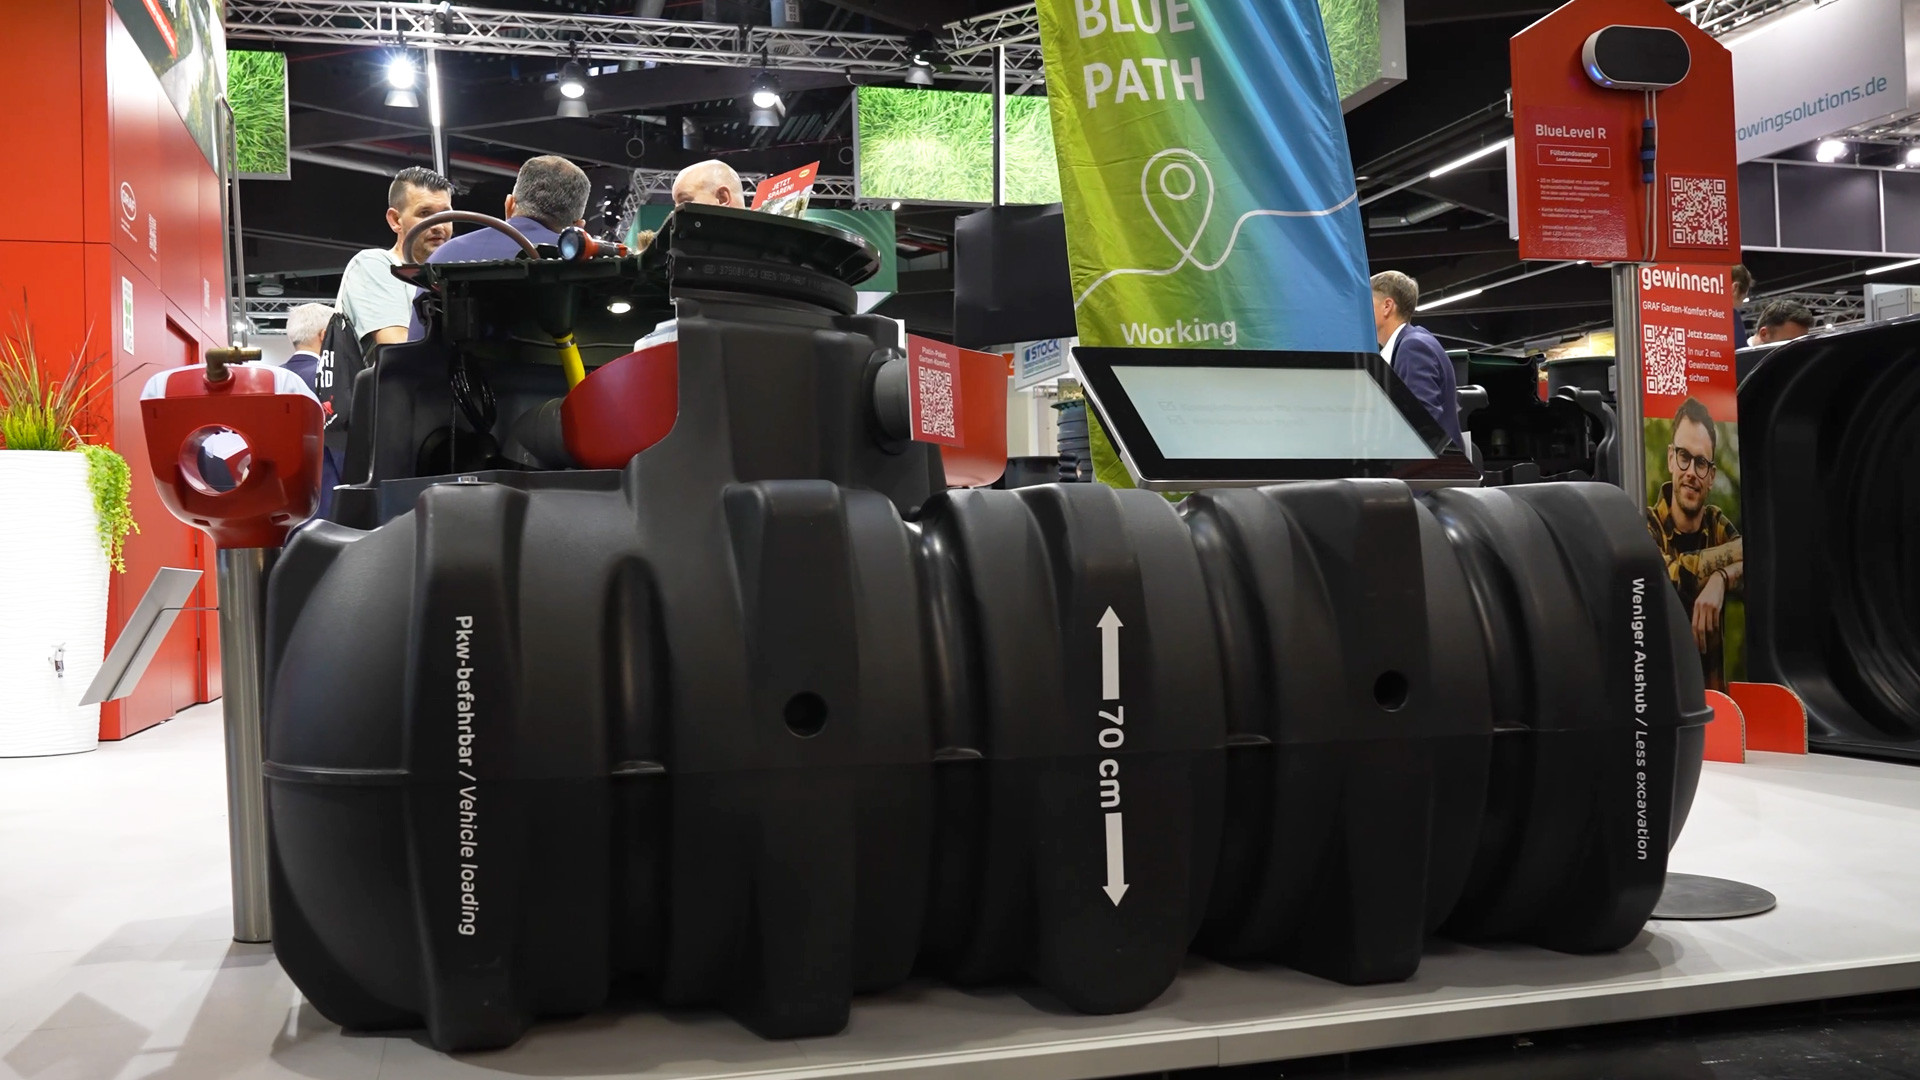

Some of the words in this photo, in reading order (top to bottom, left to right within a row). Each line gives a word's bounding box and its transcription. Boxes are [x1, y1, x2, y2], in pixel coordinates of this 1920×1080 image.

[1074, 0, 1195, 39] BLUE
[1083, 57, 1204, 109] PATH
[1736, 76, 1887, 141] owingsolutions.de
[1535, 124, 1595, 139] BlueLevel
[1598, 127, 1607, 139] R
[767, 183, 795, 200] SPAREN!
[772, 177, 791, 191] JETZT
[1642, 266, 1724, 295] gewinnen!
[1642, 301, 1660, 310] GRAF
[1661, 303, 1708, 317] Garten-Komfort
[1708, 309, 1725, 319] Paket
[1120, 318, 1237, 346] Working
[1687, 329, 1703, 339] Jetzt
[1703, 332, 1728, 341] scannen
[1030, 339, 1060, 360] STOCK
[1694, 349, 1704, 357] nur
[1705, 348, 1709, 357] 2
[1688, 360, 1729, 372] Gewinnchance
[1688, 373, 1710, 383] sichern
[1631, 578, 1646, 648] Weniger
[455, 615, 476, 767] Pkw-befahrbar
[1634, 650, 1648, 714] Aushub
[1098, 705, 1125, 749] 70
[1634, 717, 1648, 727] /
[1635, 730, 1648, 767] Less
[458, 770, 477, 782] /
[1098, 758, 1121, 808] cm
[459, 786, 478, 858] Vehicle
[1636, 771, 1650, 861] excavation
[458, 863, 479, 936] loading
